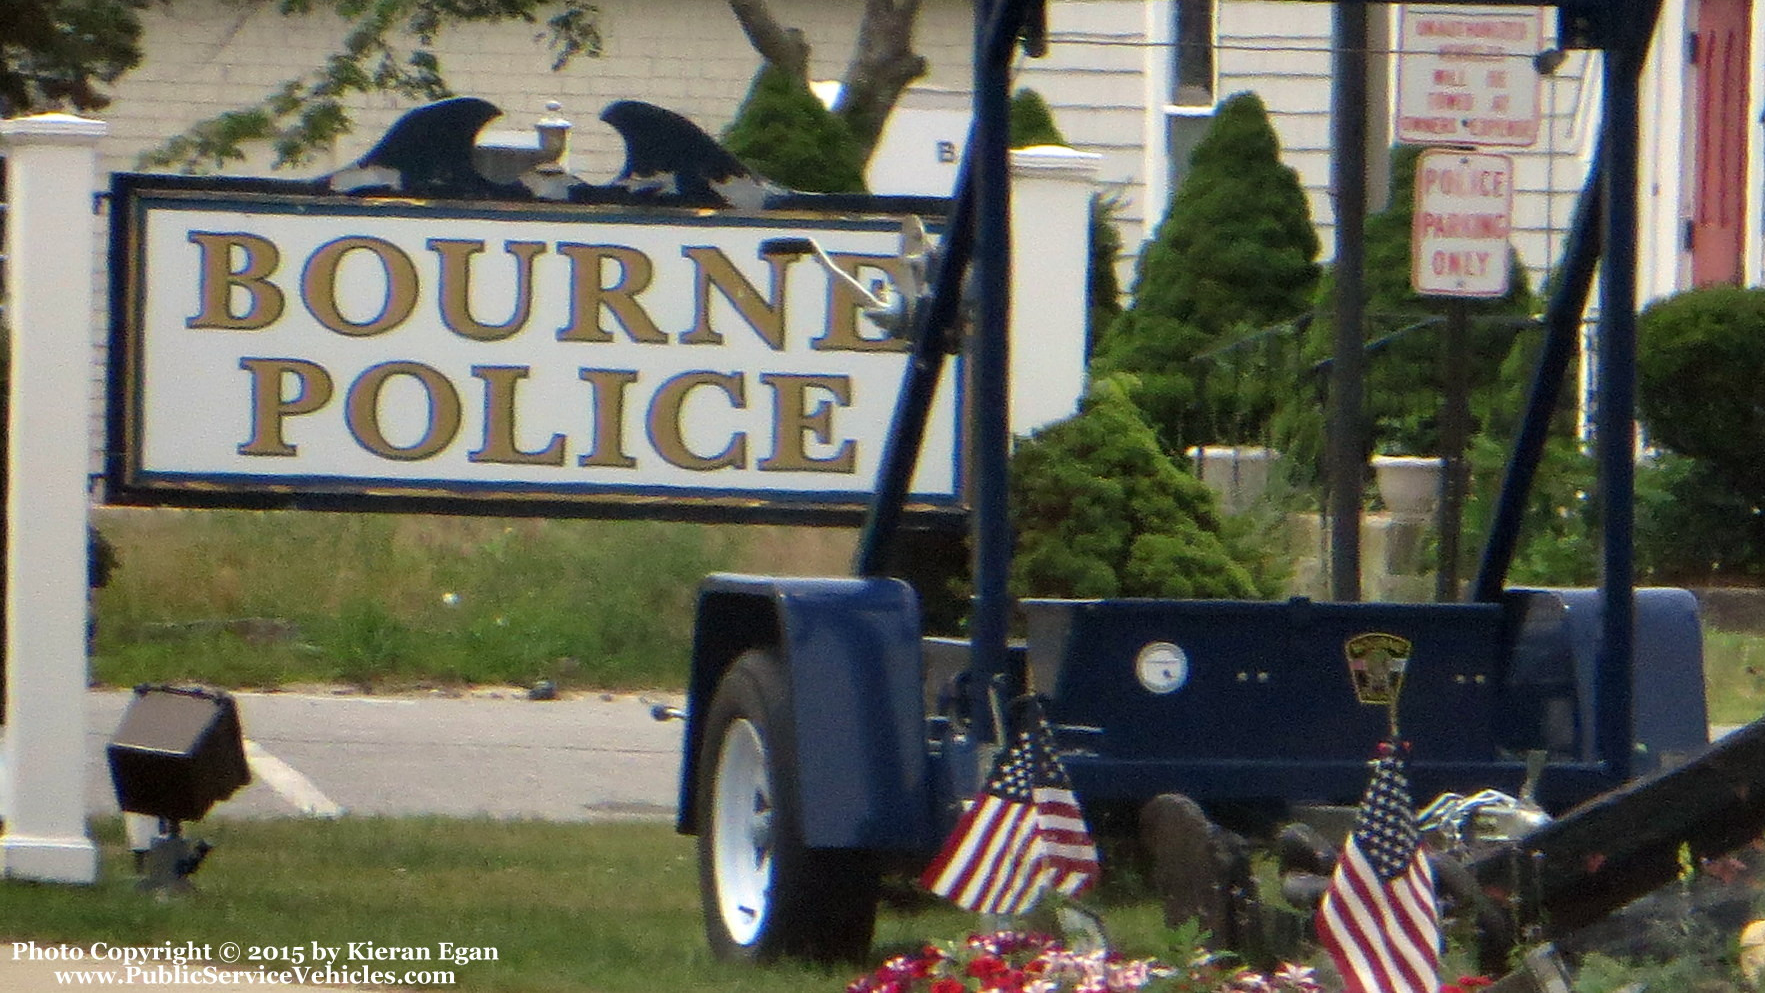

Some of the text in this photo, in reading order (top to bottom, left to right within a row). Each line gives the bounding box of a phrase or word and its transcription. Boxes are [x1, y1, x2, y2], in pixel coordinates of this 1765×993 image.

[1424, 168, 1505, 198] POLICE
[1423, 212, 1508, 240] PARKING
[1432, 250, 1491, 277] ONLY
[185, 230, 910, 353] BOURNE
[238, 356, 858, 474] POLICE
